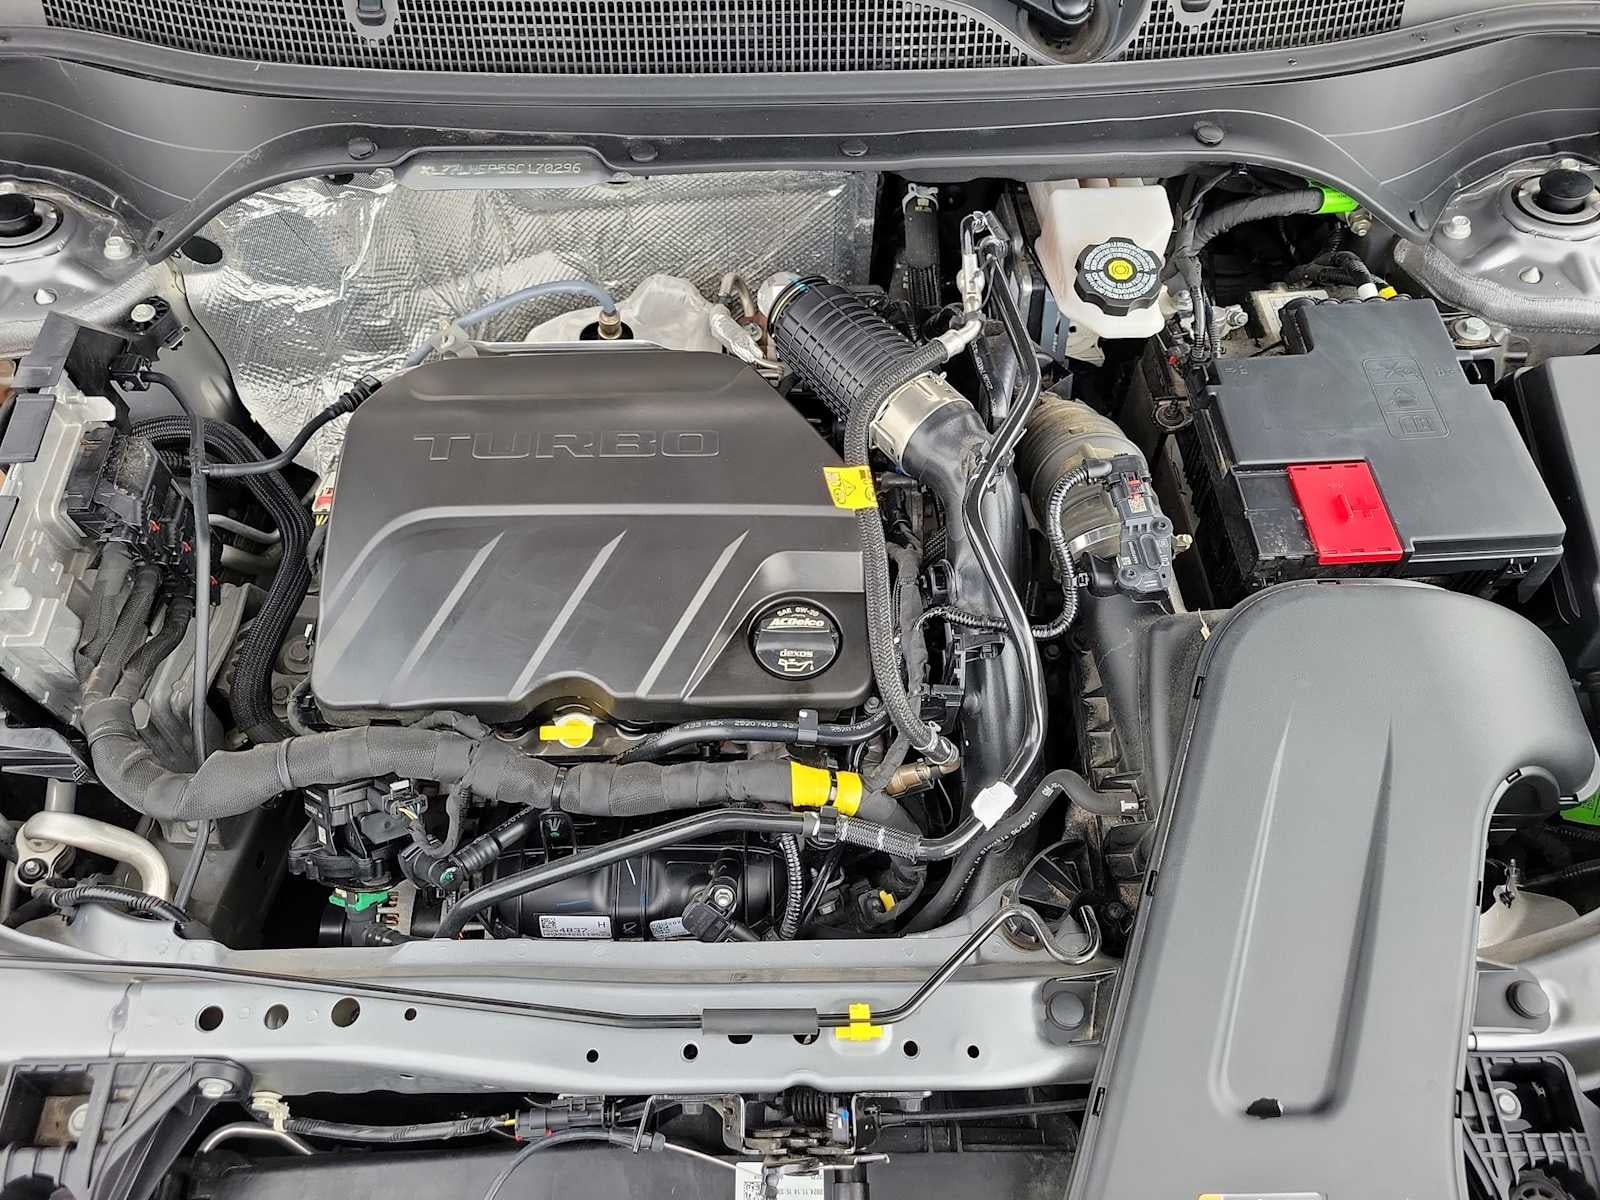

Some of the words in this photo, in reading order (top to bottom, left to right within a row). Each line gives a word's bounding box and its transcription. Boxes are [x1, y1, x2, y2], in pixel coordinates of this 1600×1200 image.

[413, 430, 719, 460] TURBO
[769, 617, 825, 627] ACDelco
[780, 648, 813, 657] dexos
